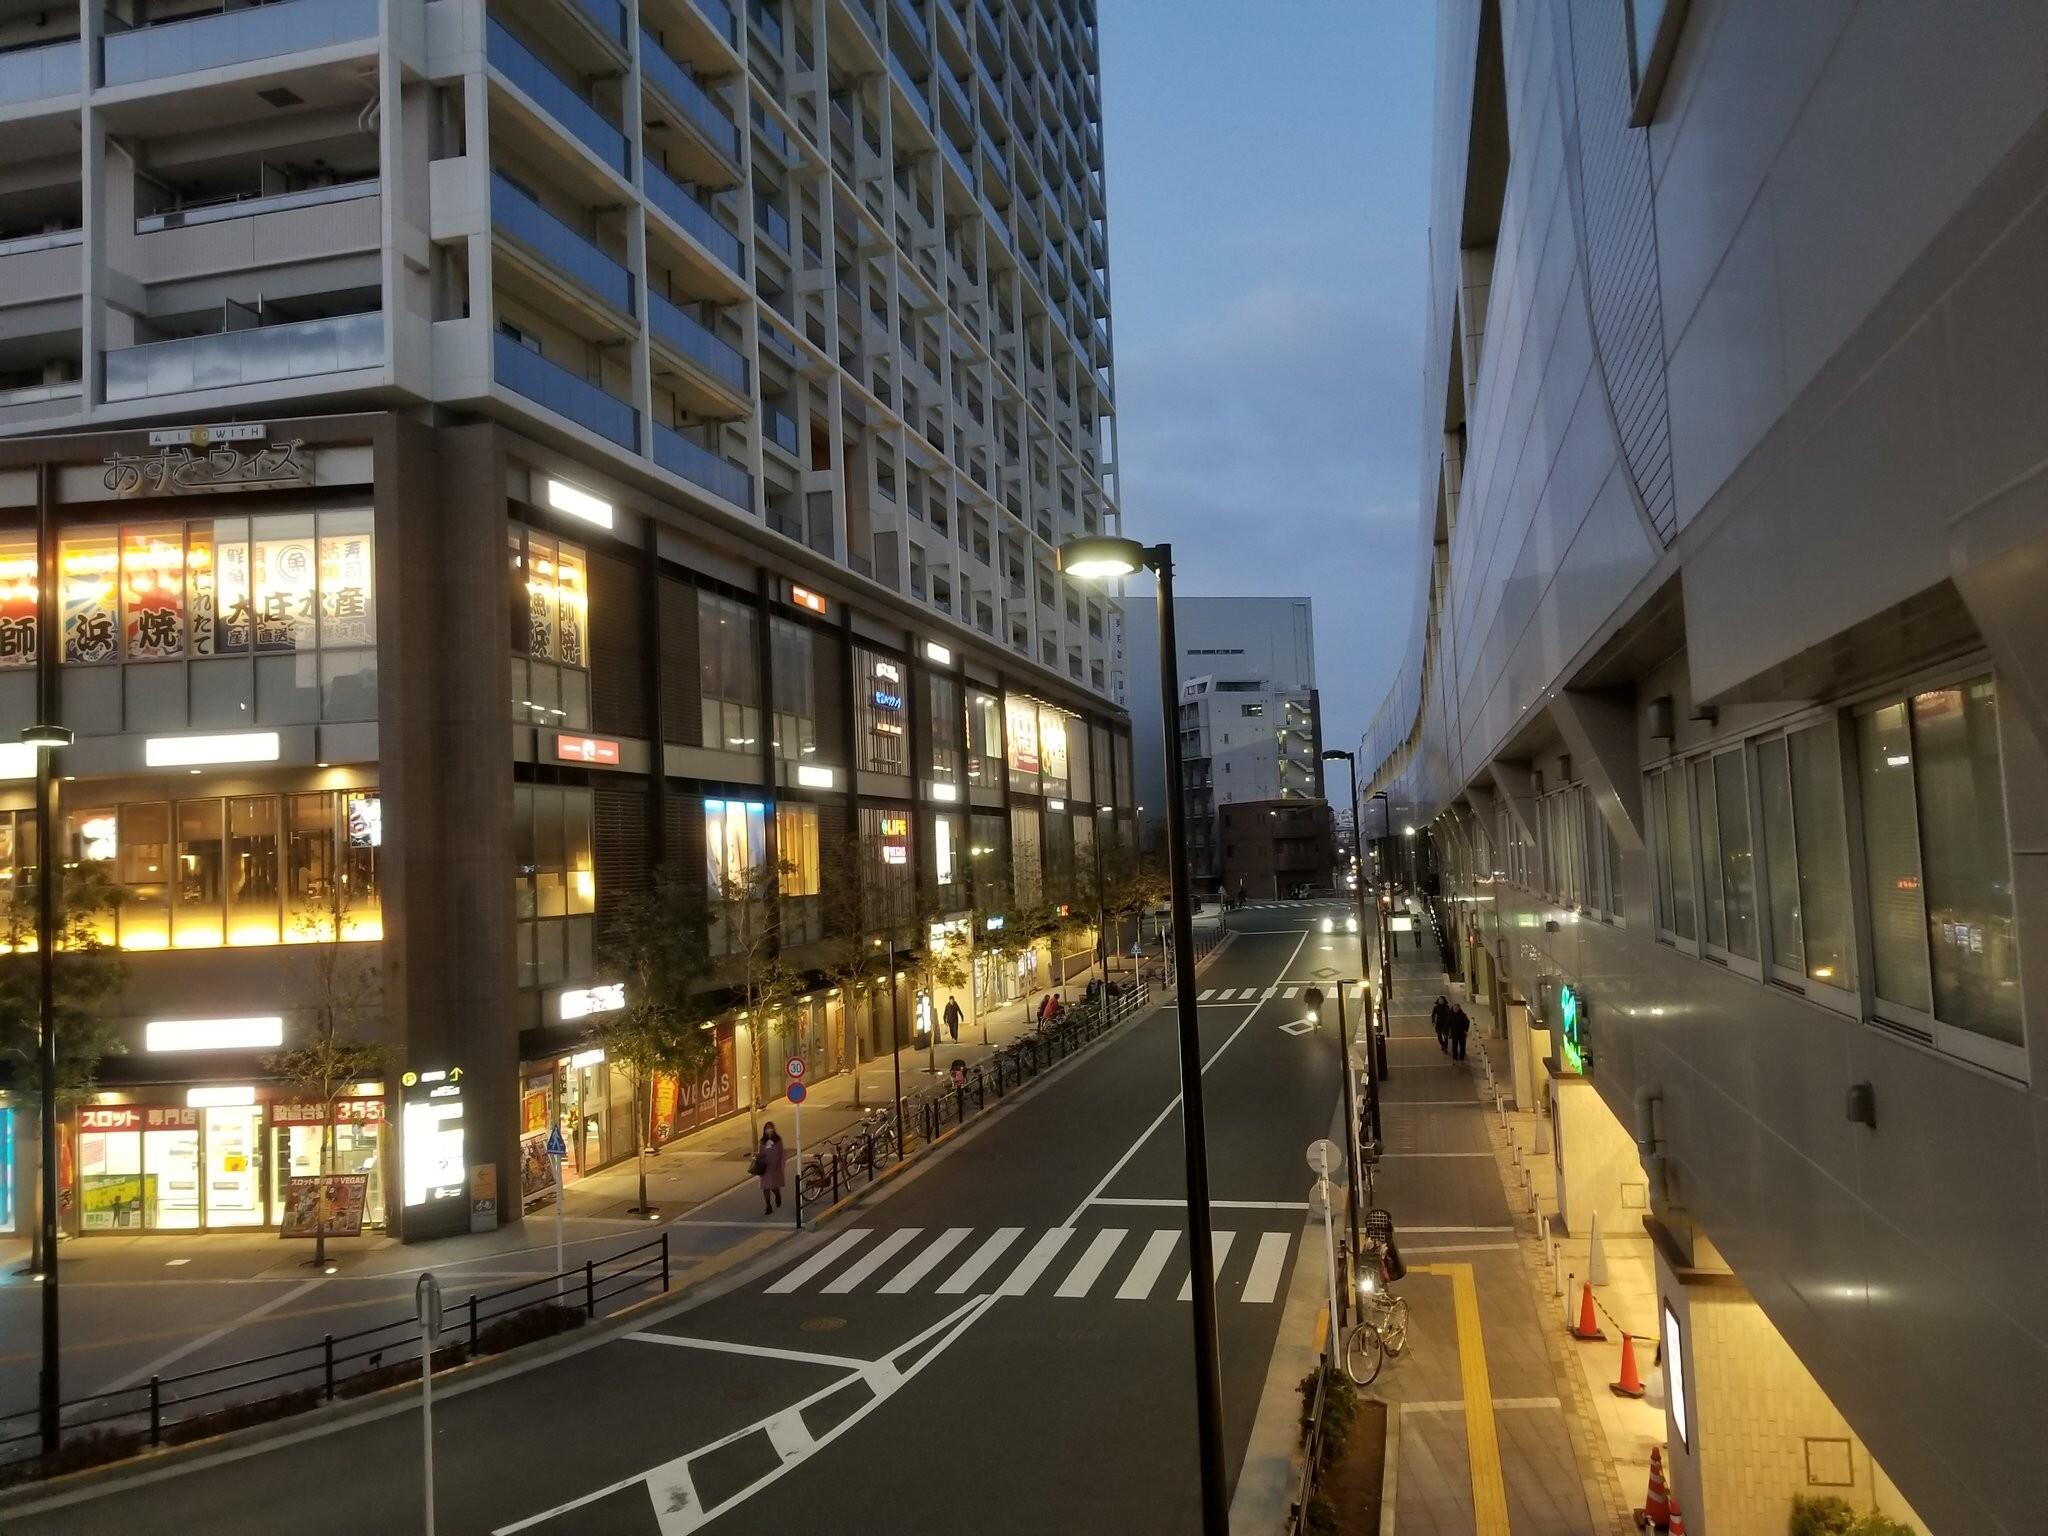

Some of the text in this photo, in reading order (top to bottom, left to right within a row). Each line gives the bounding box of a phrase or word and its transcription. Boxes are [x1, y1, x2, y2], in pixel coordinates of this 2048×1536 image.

[154, 428, 259, 442] AL TO WITH
[343, 540, 363, 578] 寿司
[227, 586, 367, 624] 大庄水産
[0, 617, 36, 656] 師
[888, 819, 907, 836] LIFE
[791, 1063, 802, 1073] 30
[681, 1073, 730, 1107] VEGAS
[82, 1107, 197, 1128] スロット 専門店
[339, 1176, 366, 1185] VEGAS
